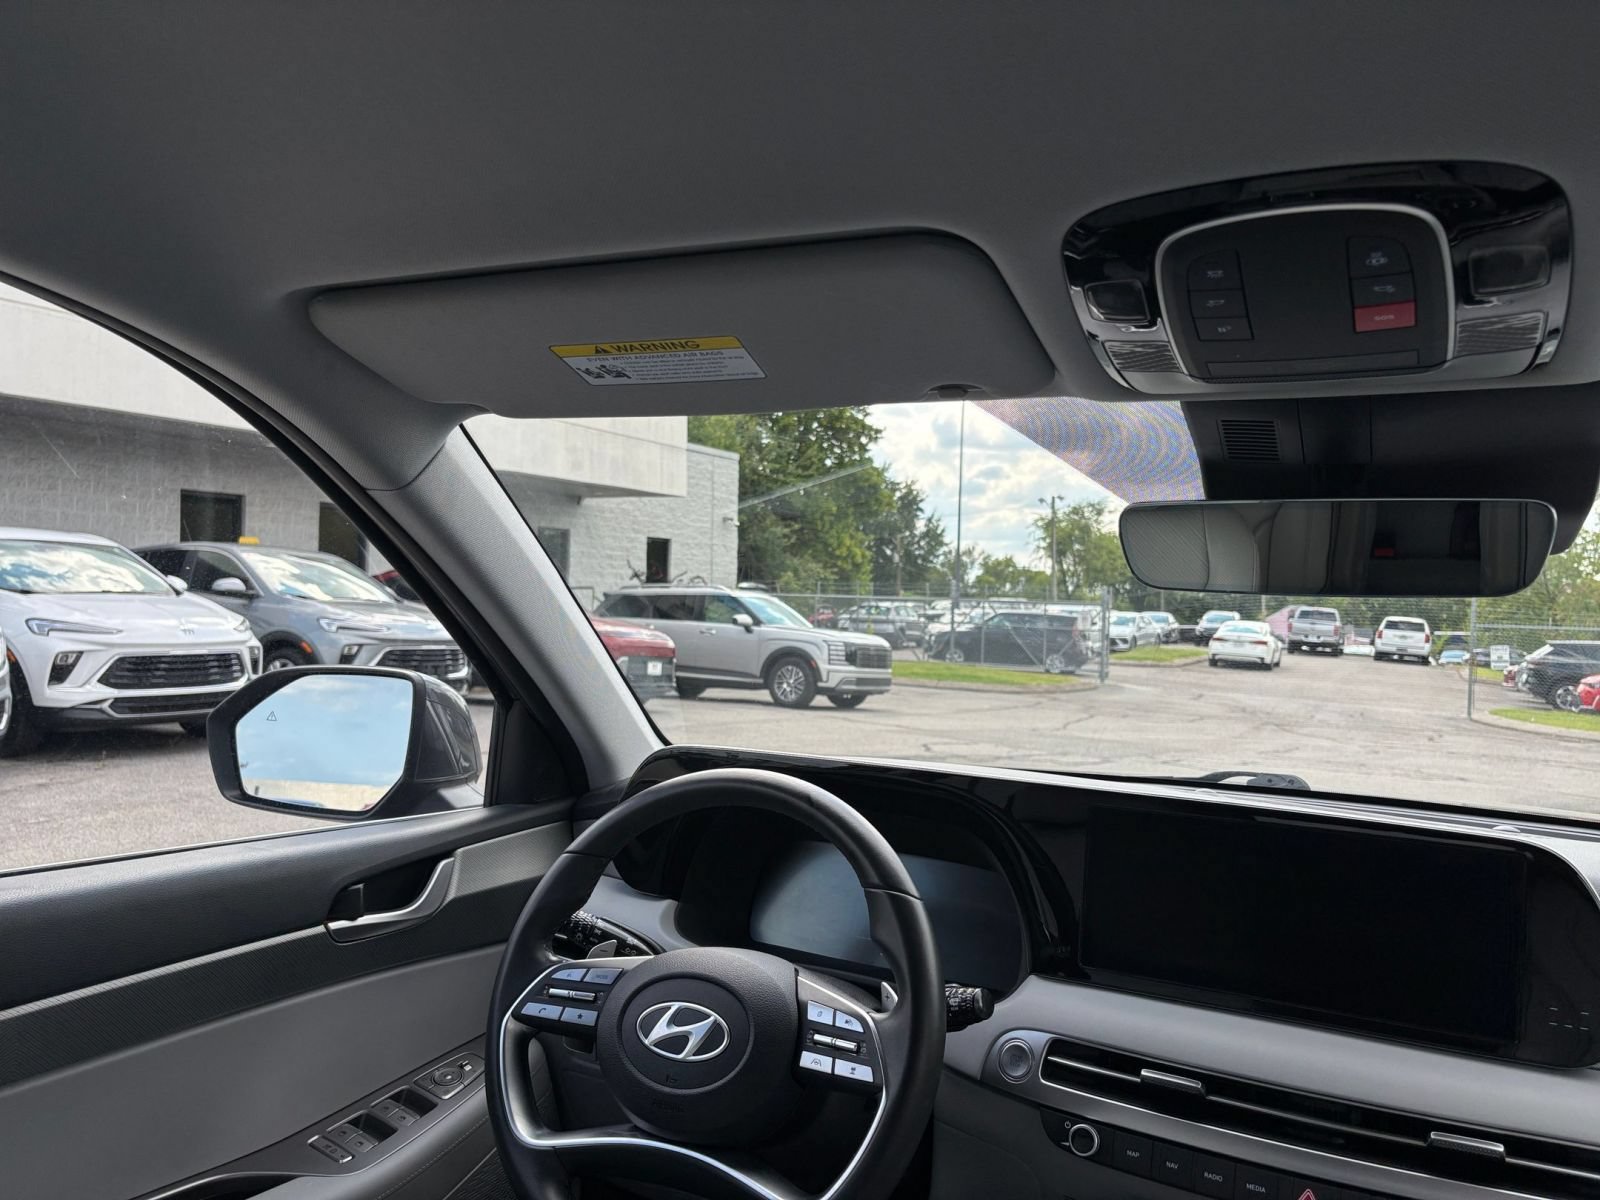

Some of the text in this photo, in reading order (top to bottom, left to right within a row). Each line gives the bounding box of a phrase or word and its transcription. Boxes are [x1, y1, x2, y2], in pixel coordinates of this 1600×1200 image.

[610, 341, 700, 353] WARNING
[1126, 1150, 1140, 1158] MAP
[1166, 1161, 1179, 1169] NAV
[1204, 1172, 1223, 1182] RADIO
[1246, 1183, 1266, 1193] MEDIA
